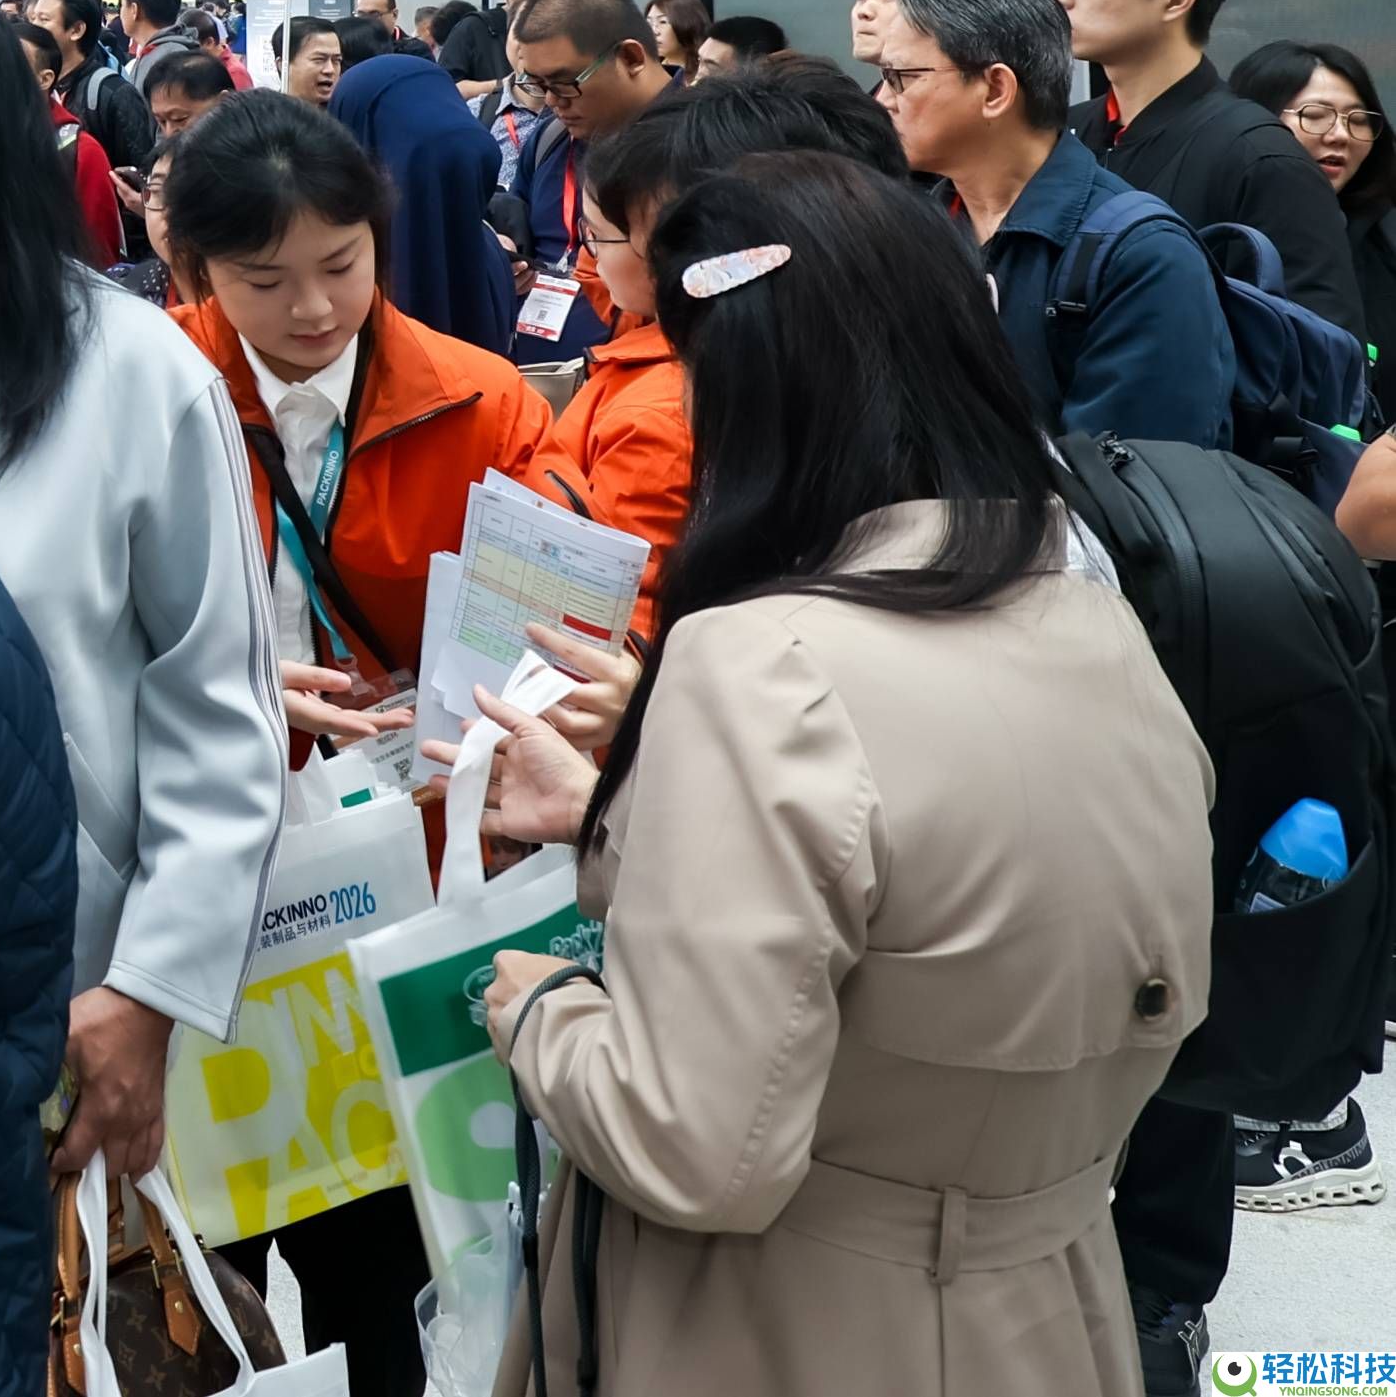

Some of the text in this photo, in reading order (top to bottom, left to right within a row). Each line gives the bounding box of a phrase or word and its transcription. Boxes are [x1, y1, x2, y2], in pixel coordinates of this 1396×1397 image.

[262, 881, 377, 932] CKINNO 2026
[257, 913, 331, 952] 装制品与材料
